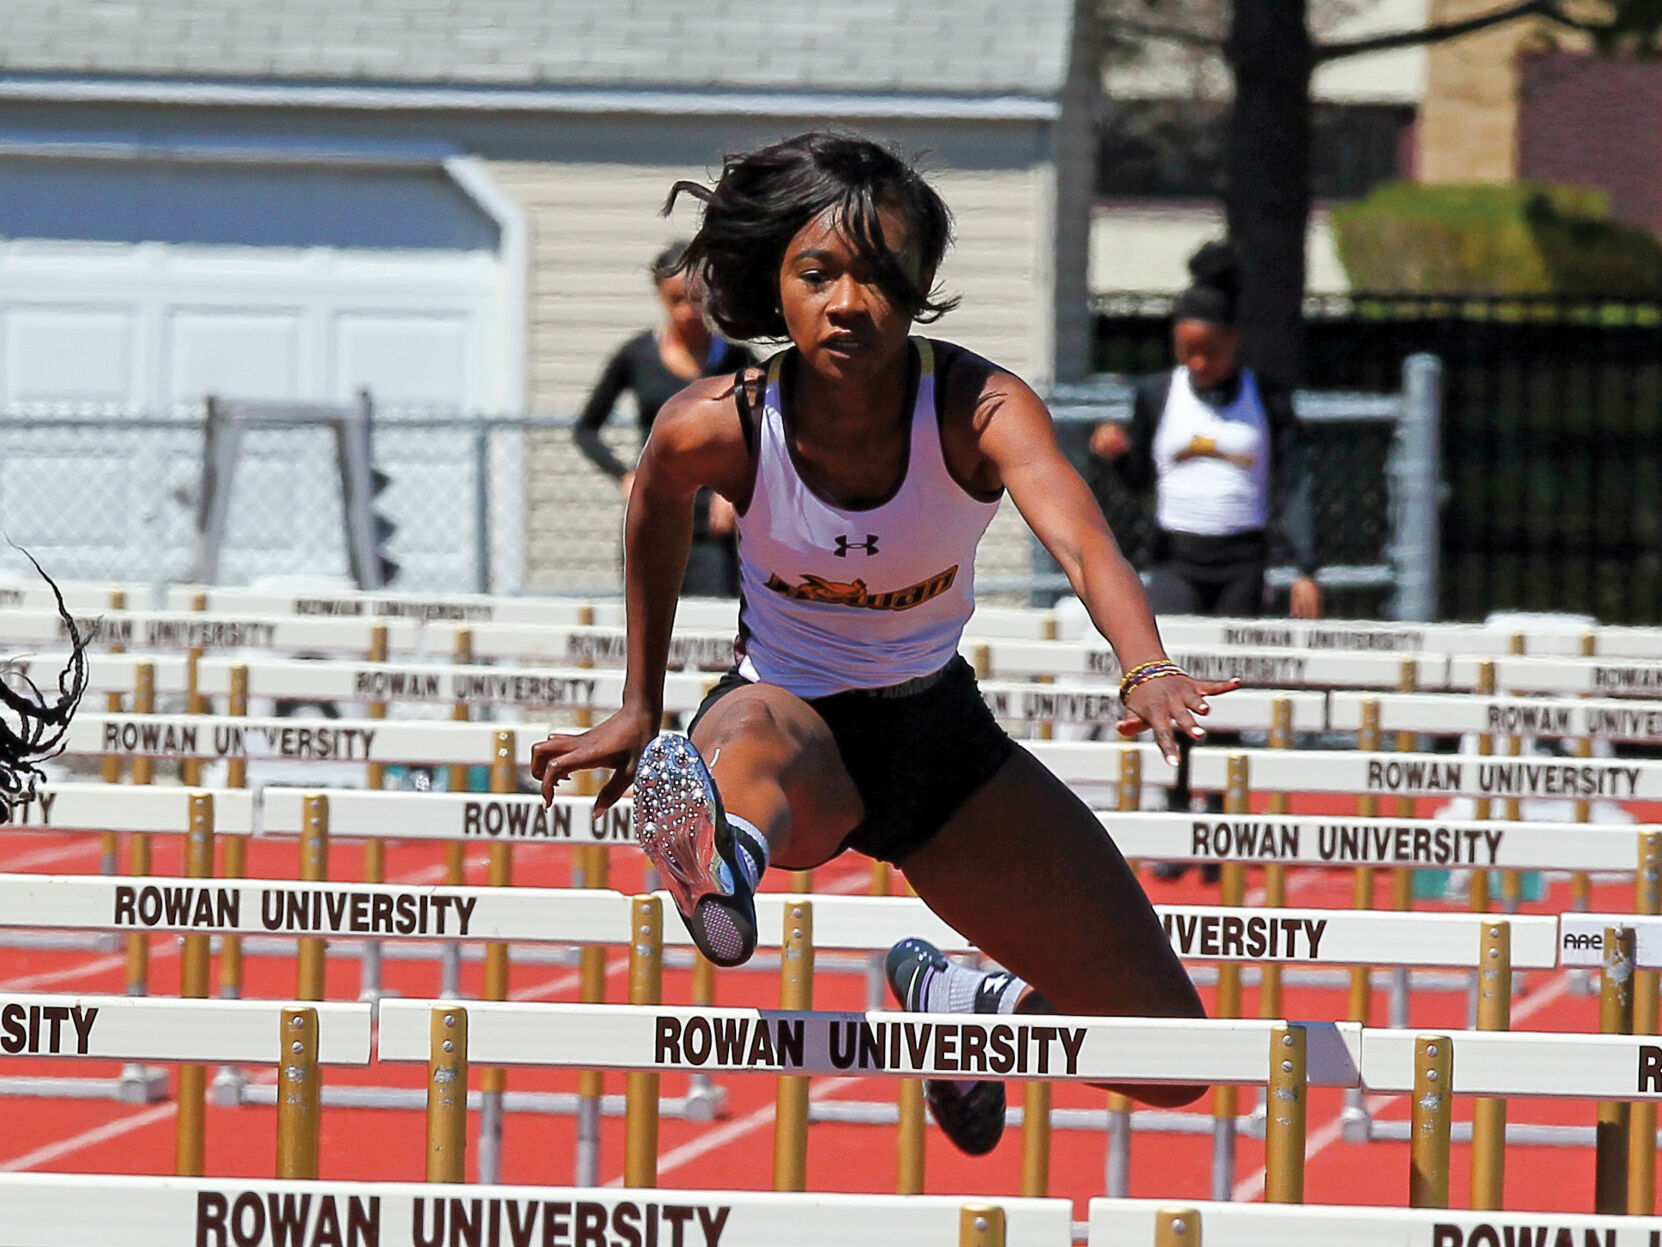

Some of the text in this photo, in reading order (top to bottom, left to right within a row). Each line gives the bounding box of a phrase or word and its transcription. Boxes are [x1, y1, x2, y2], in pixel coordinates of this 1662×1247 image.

[356, 671, 595, 703] ROWAN UNIVERSITY
[1488, 706, 1568, 732] ROWAN
[105, 723, 197, 752] ROWAN
[1369, 761, 1640, 796] ROWAN UNIVERSITY
[463, 802, 571, 838] ROWAN
[1192, 822, 1504, 864] ROWAN UNIVERSITY
[114, 886, 477, 936] ROWAN UNIVERSITY
[654, 1016, 1088, 1075] ROWAN UNIVERSITY
[196, 1191, 731, 1247] ROWAN UNIVERSITY
